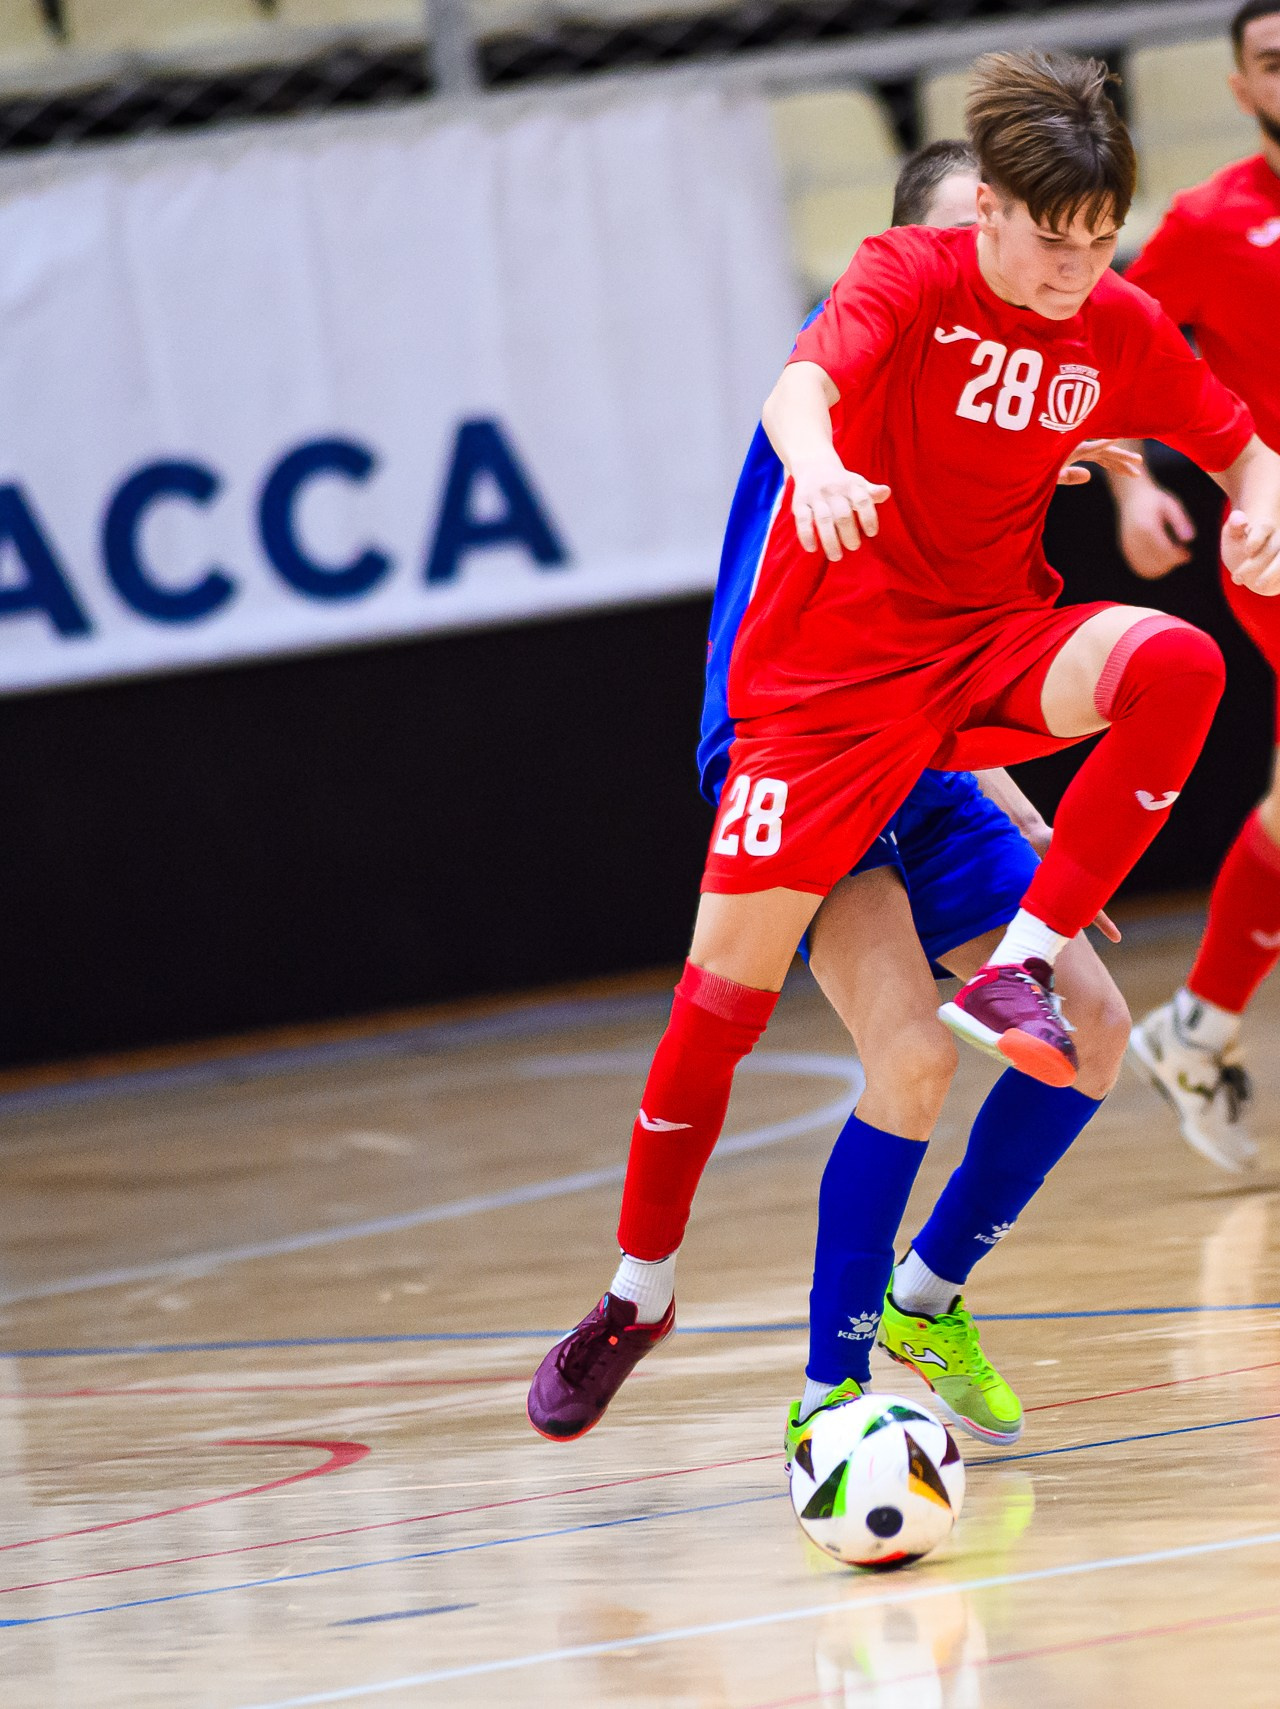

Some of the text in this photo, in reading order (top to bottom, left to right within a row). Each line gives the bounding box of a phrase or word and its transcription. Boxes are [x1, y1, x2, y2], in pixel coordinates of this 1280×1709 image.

[955, 340, 1044, 431] 28
[0, 413, 572, 641] АССА
[713, 774, 789, 857] 28
